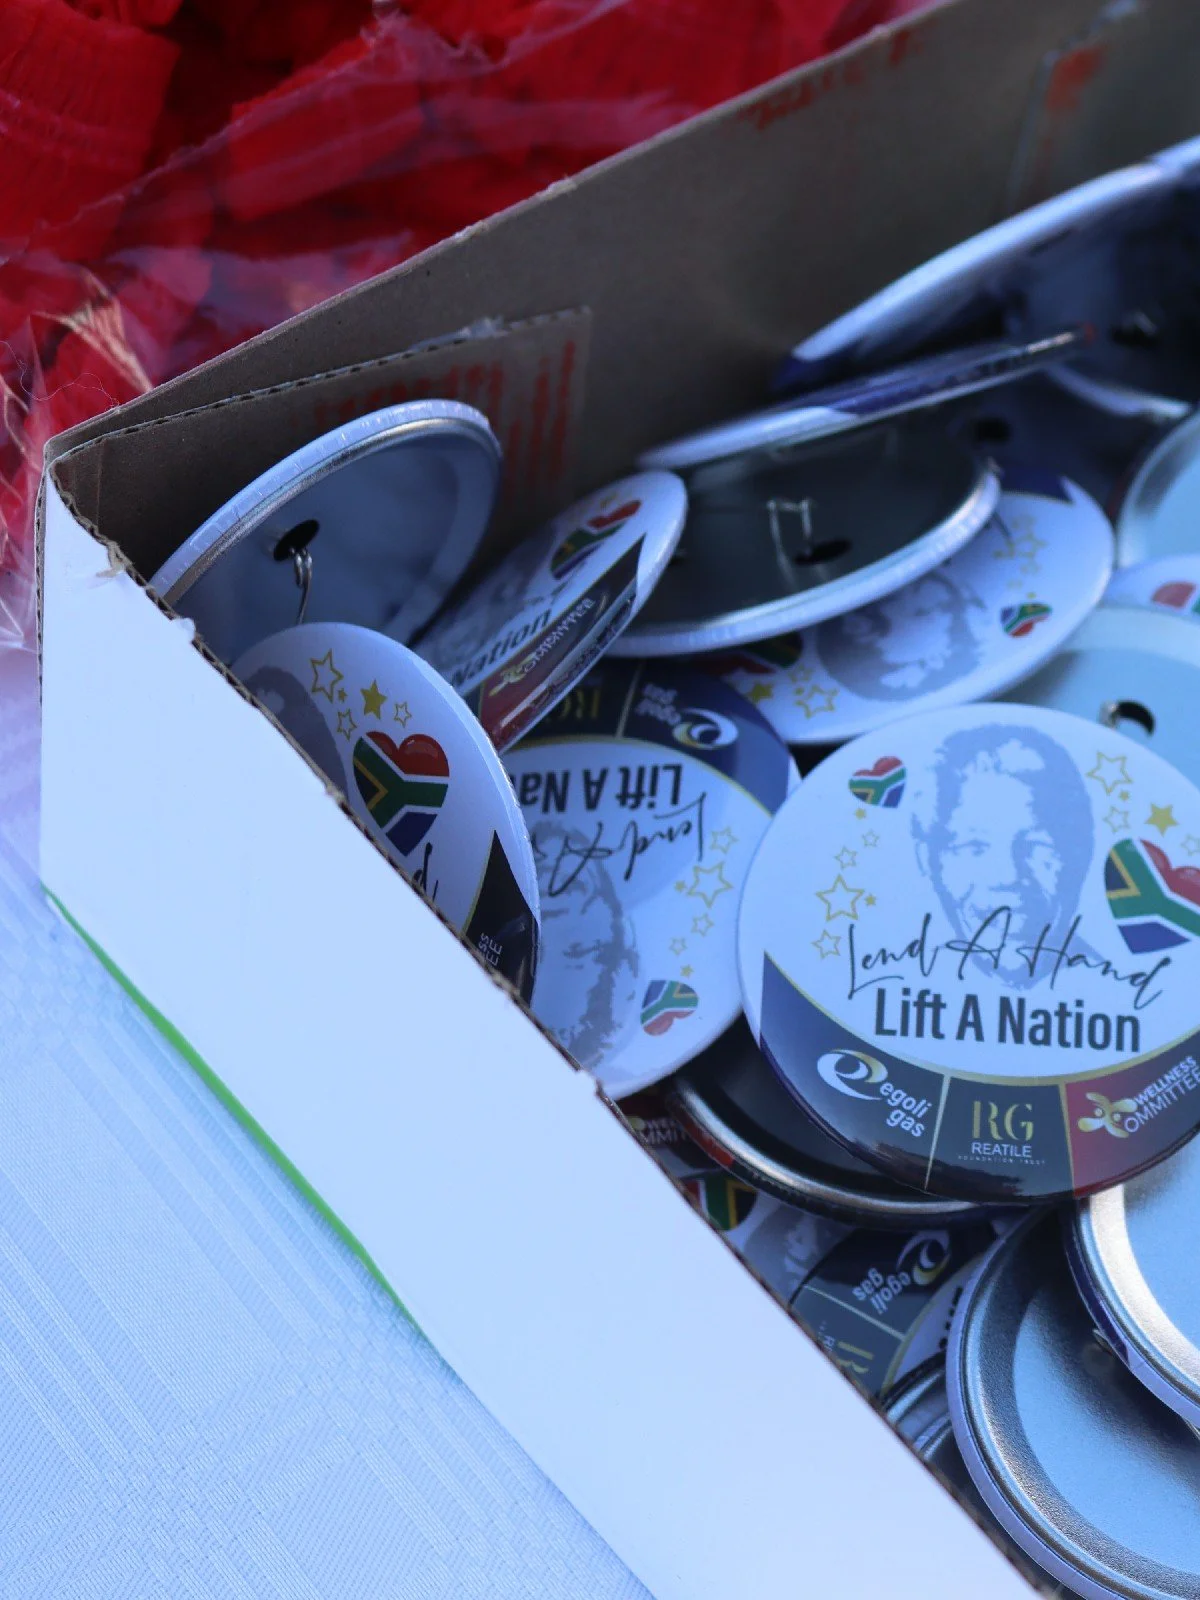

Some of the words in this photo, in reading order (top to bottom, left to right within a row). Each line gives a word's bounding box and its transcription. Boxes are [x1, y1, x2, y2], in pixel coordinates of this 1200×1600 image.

[582, 766, 609, 812] A
[615, 763, 683, 811] Lift
[848, 912, 939, 1000] Lend
[945, 905, 1011, 980] A
[1015, 913, 1171, 1011] Hand
[875, 987, 946, 1040] Lift
[955, 993, 985, 1043] A
[998, 996, 1141, 1053] Nation
[879, 1081, 933, 1119] egoli
[1133, 1055, 1197, 1105] WELLNESS
[886, 1109, 925, 1137] gas
[972, 1100, 1034, 1141] RG
[971, 1142, 1032, 1159] REATILE
[852, 1267, 884, 1301] gas
[870, 1271, 912, 1316] egoli
